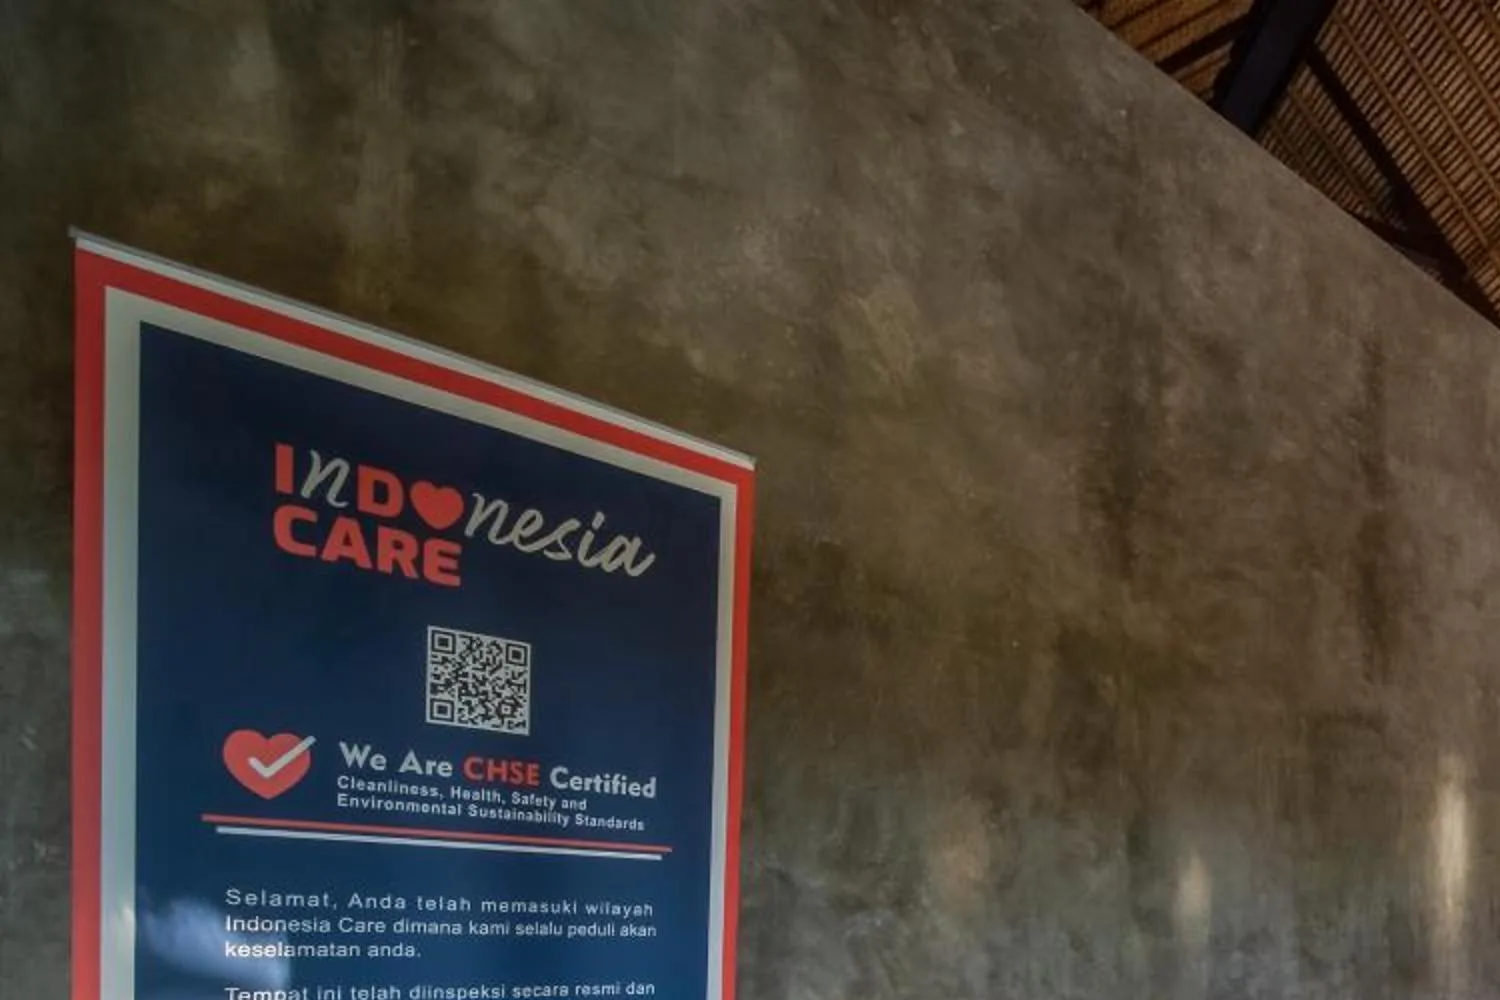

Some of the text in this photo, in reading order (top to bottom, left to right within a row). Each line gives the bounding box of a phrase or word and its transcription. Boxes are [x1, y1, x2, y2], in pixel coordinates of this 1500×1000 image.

[273, 505, 462, 587] CARE
[339, 742, 657, 799] We Are CHSE Certified
[337, 776, 444, 799] Cleanliness,
[512, 791, 556, 810] Safety
[562, 798, 587, 811] and
[337, 794, 645, 830] Environmental Sustainability Standards
[226, 889, 654, 919] Selamat, Anda telah memasuki wilayah
[226, 916, 656, 939] Indonesia Care dimana kami selalu peduli akan
[225, 941, 421, 958] keselamatan anda.
[317, 987, 342, 1000] ini
[351, 986, 401, 1000] telah
[512, 984, 568, 997] secara
[576, 982, 620, 997] resmi
[626, 982, 655, 996] dan
